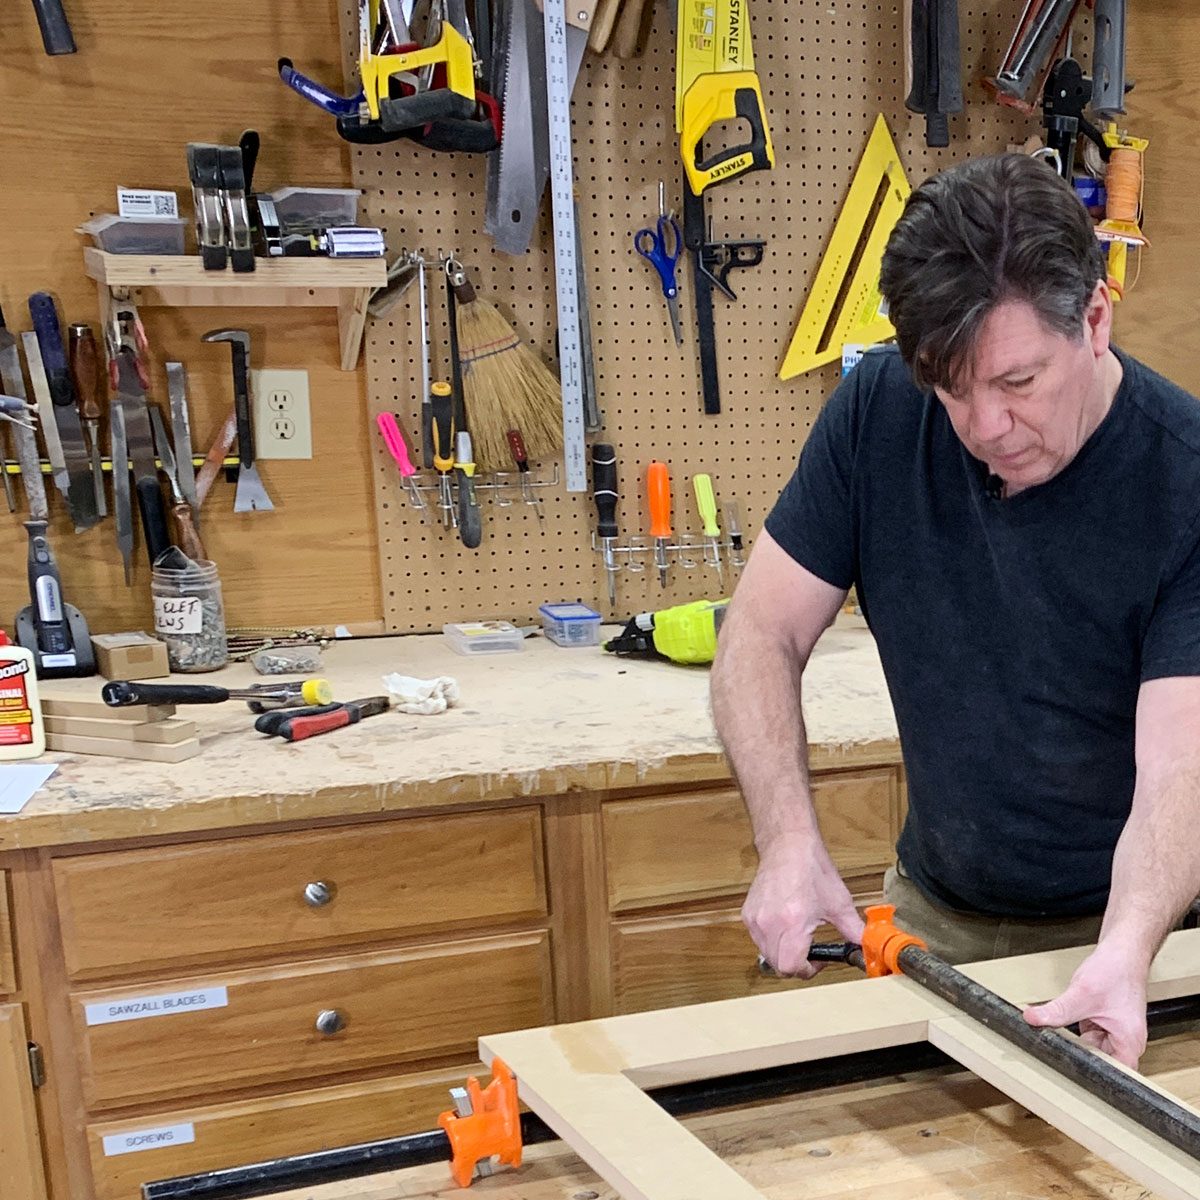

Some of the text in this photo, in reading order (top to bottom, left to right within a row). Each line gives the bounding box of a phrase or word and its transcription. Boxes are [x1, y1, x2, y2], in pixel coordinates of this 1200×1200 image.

[728, 0, 740, 65] STANLEY
[709, 157, 746, 180] STANLEY
[108, 994, 207, 1016] SAWZALL BLADES
[126, 1131, 174, 1147] SCREWS
